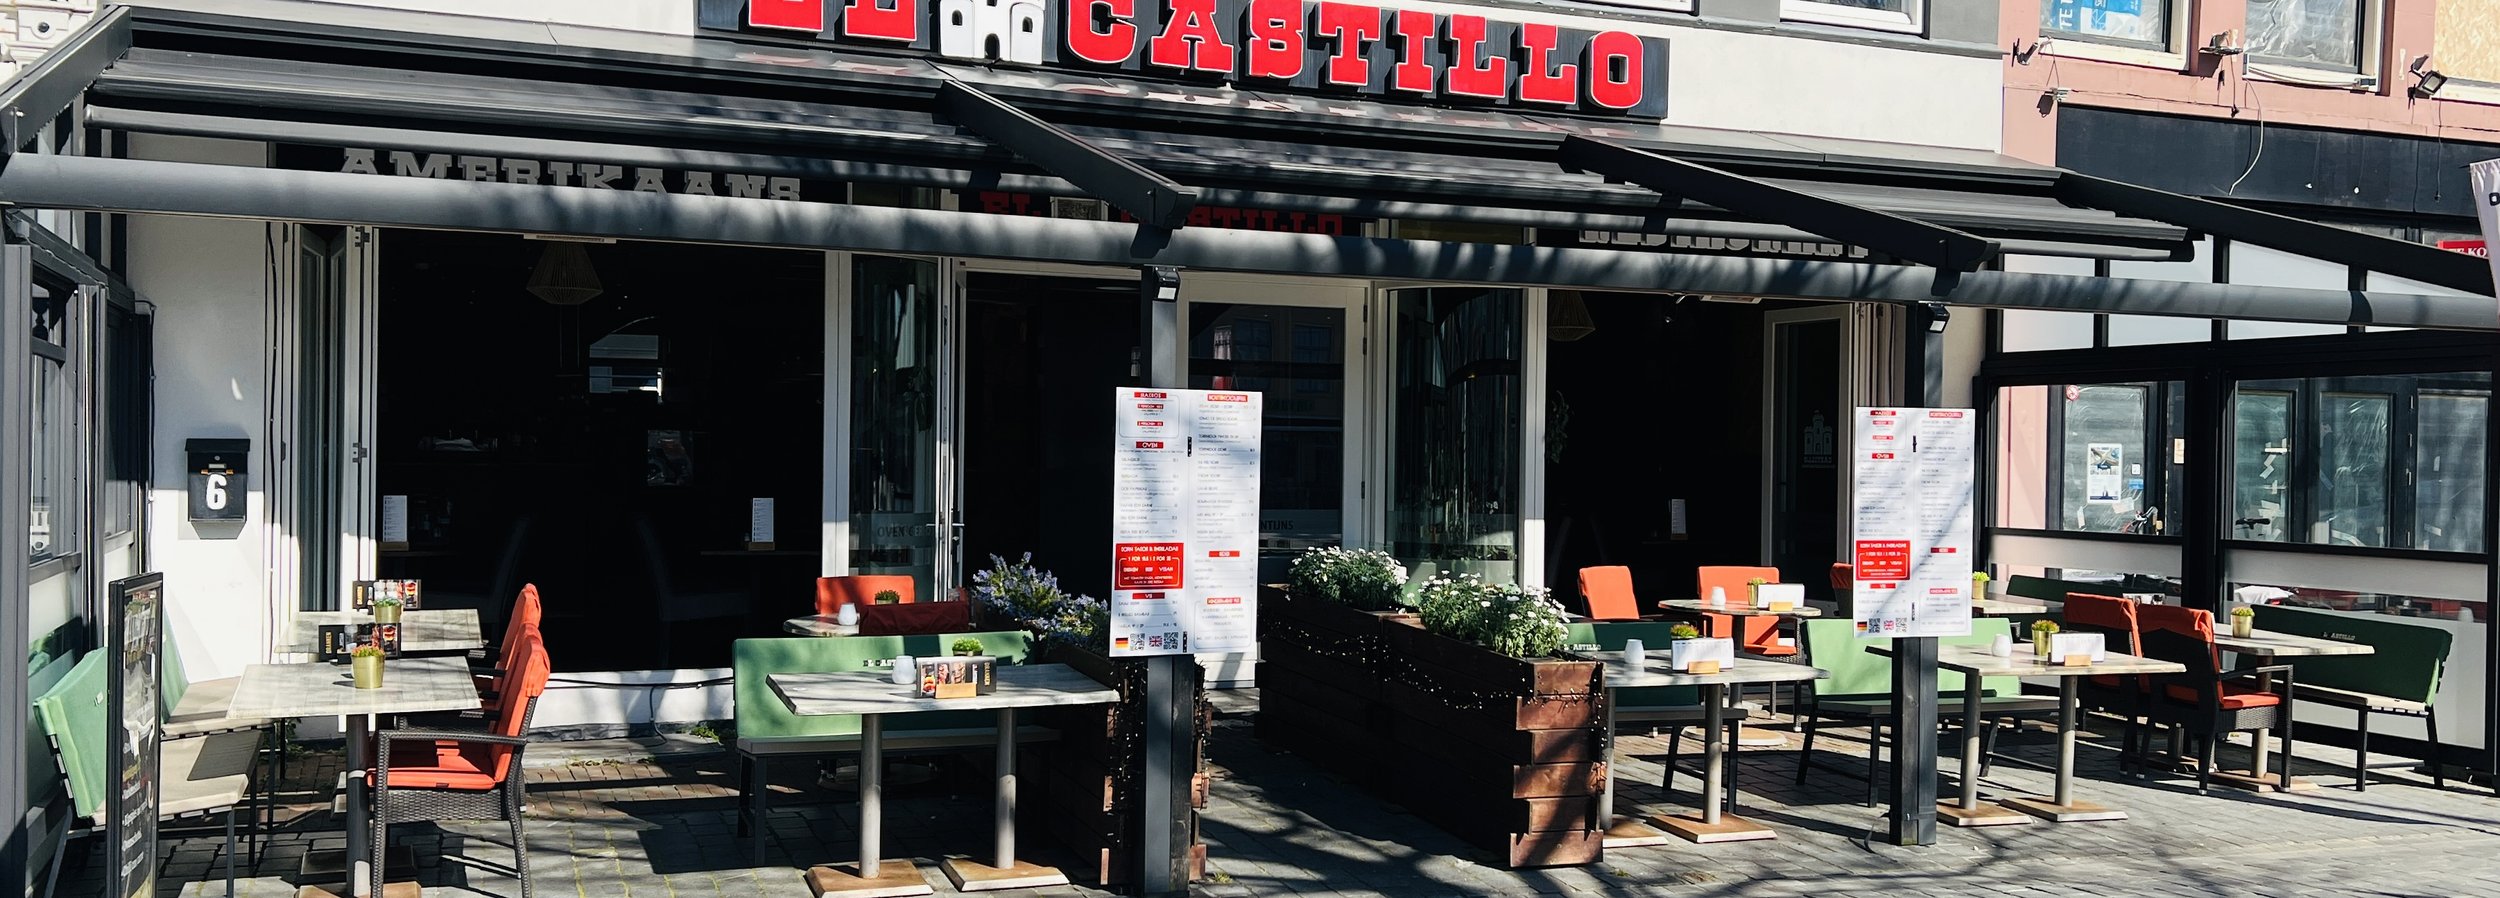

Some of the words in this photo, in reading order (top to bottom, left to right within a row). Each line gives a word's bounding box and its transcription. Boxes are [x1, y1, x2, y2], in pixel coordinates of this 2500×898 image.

[1068, 0, 1644, 109] CASTILLO
[340, 148, 801, 202] AMERIKAANS
[206, 475, 227, 511] 6
[1260, 520, 1294, 530] NTIJNS
